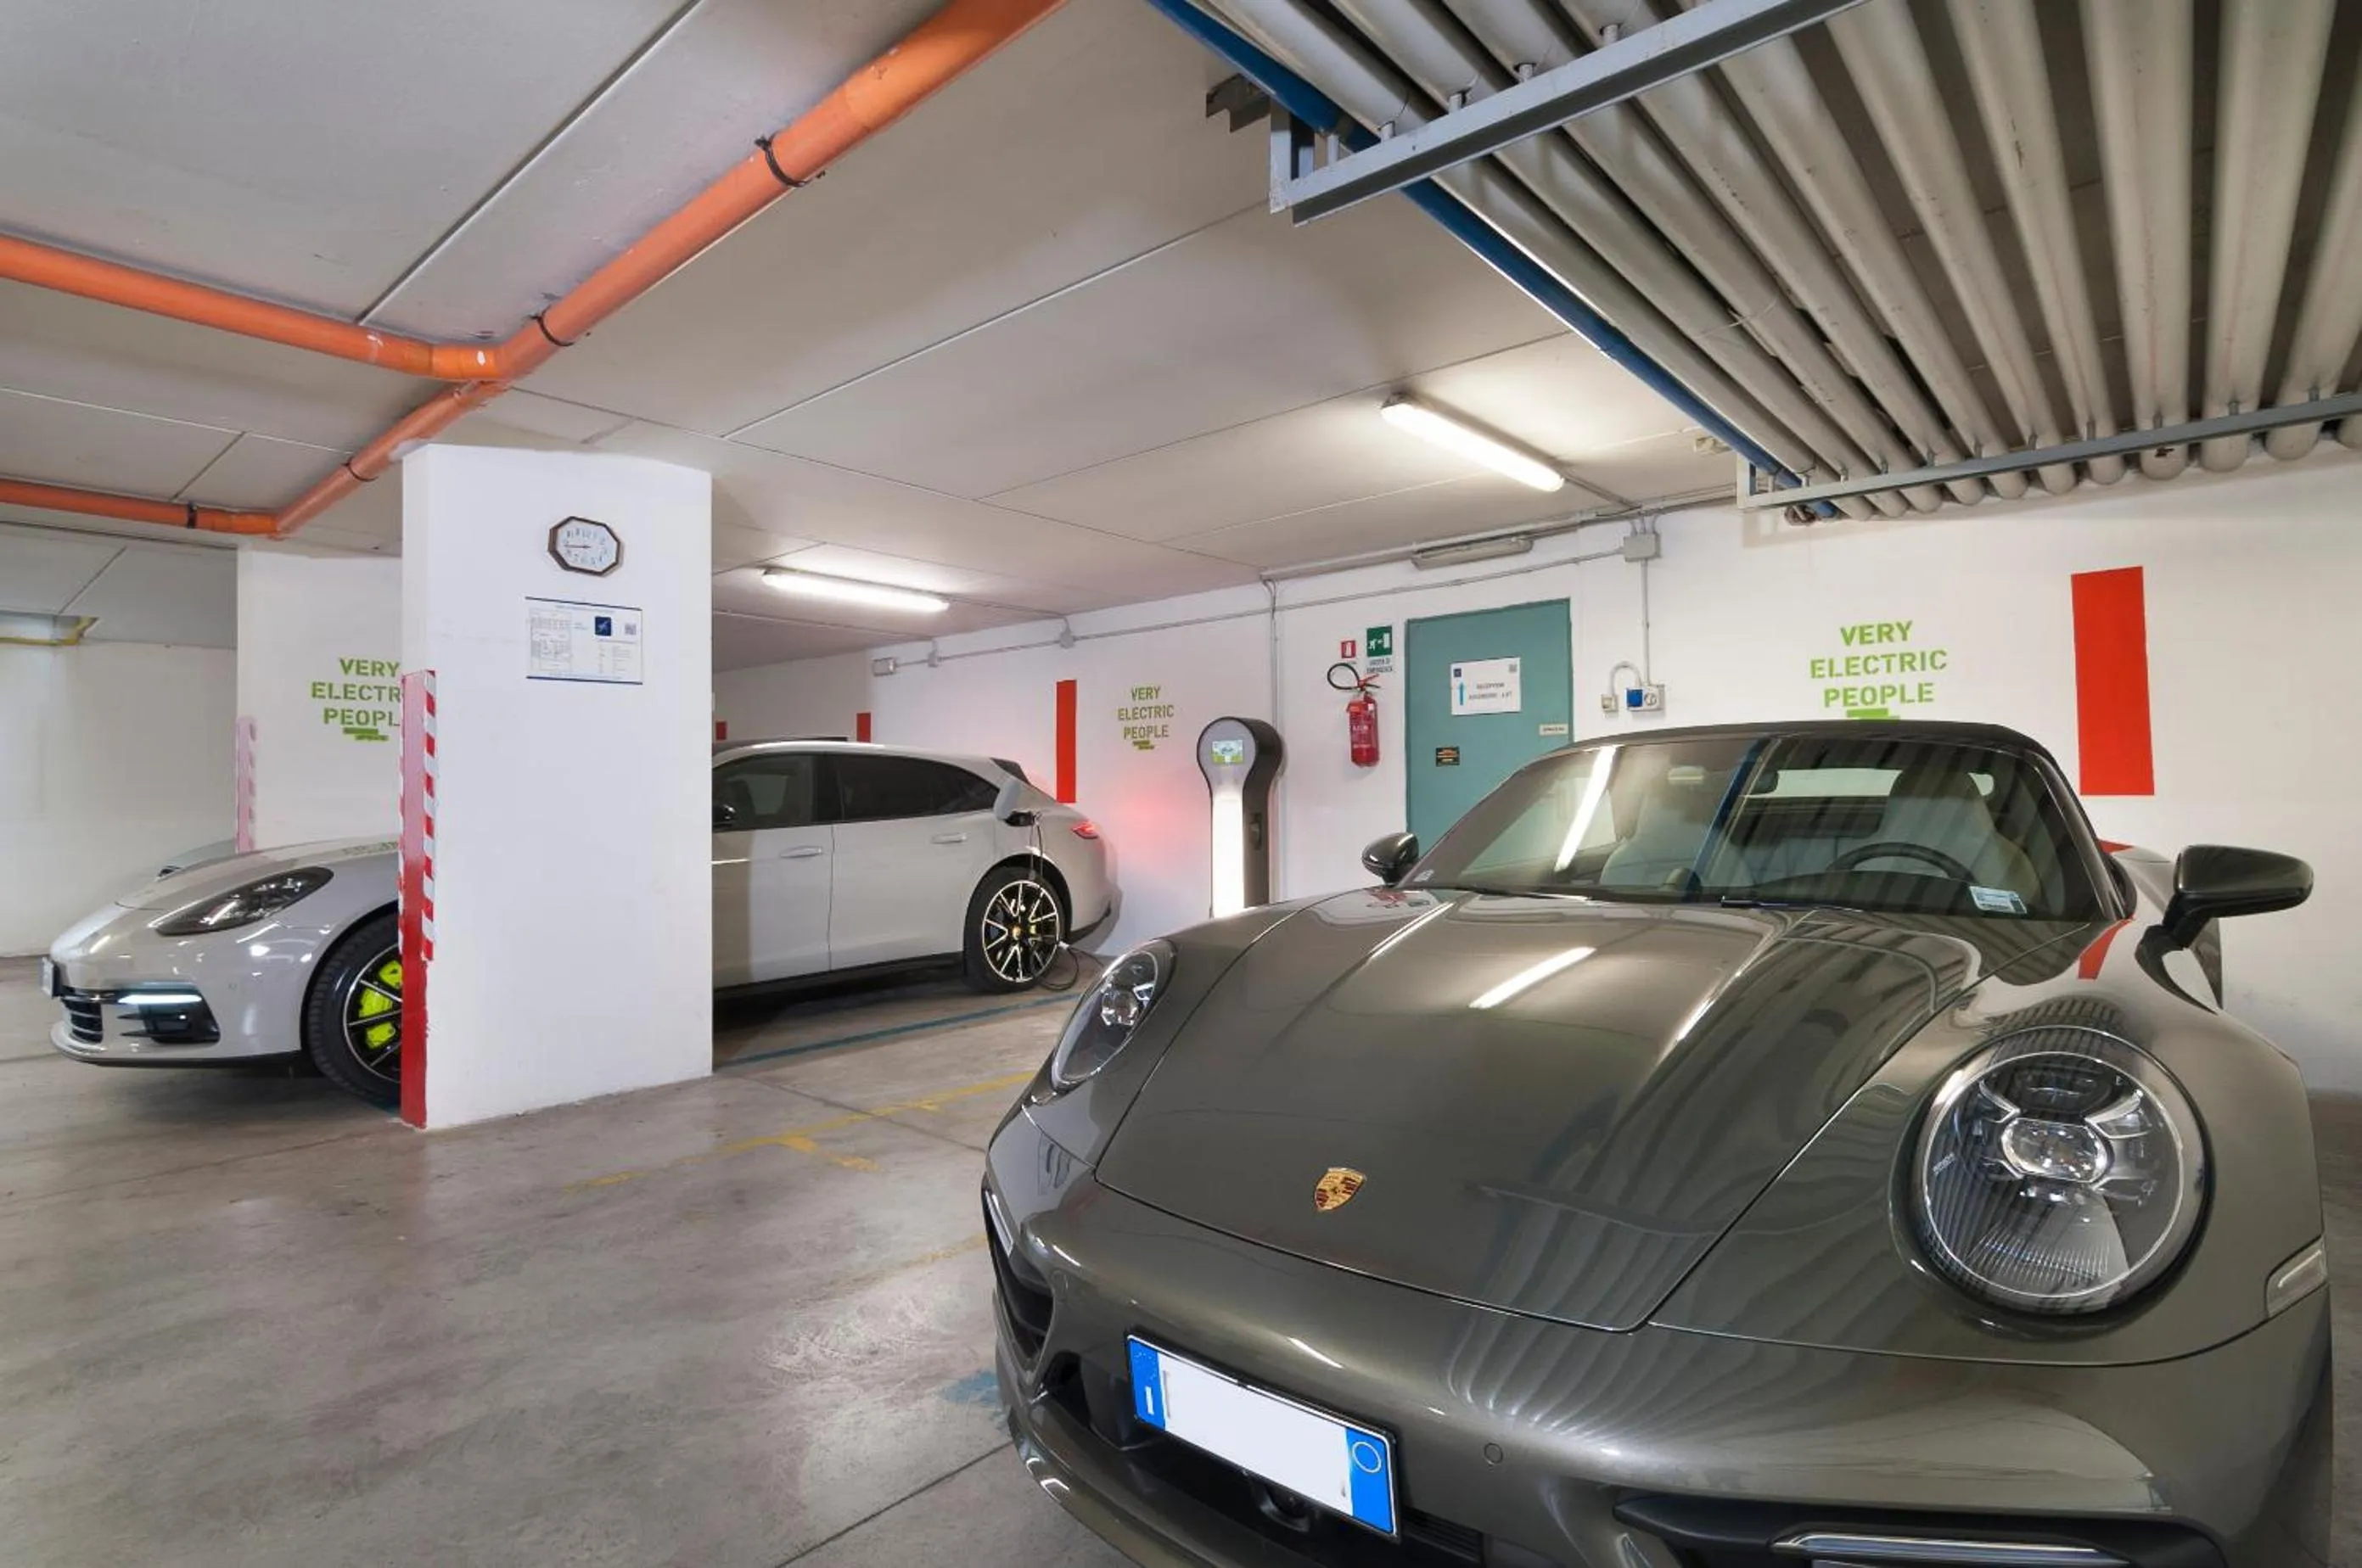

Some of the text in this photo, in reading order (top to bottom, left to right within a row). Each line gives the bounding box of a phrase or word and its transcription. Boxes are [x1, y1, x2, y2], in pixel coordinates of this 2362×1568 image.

[1840, 620, 1912, 647] VERY
[339, 658, 400, 678] VERY
[1809, 649, 1947, 680] ELECTRIC
[311, 681, 401, 703] ELECTR
[1131, 686, 1161, 701] VERY
[1824, 682, 1934, 708] PEOPLE
[323, 707, 401, 727] PEOPL
[1117, 704, 1175, 721] ELECTRIC
[1124, 724, 1170, 740] PEOPLE
